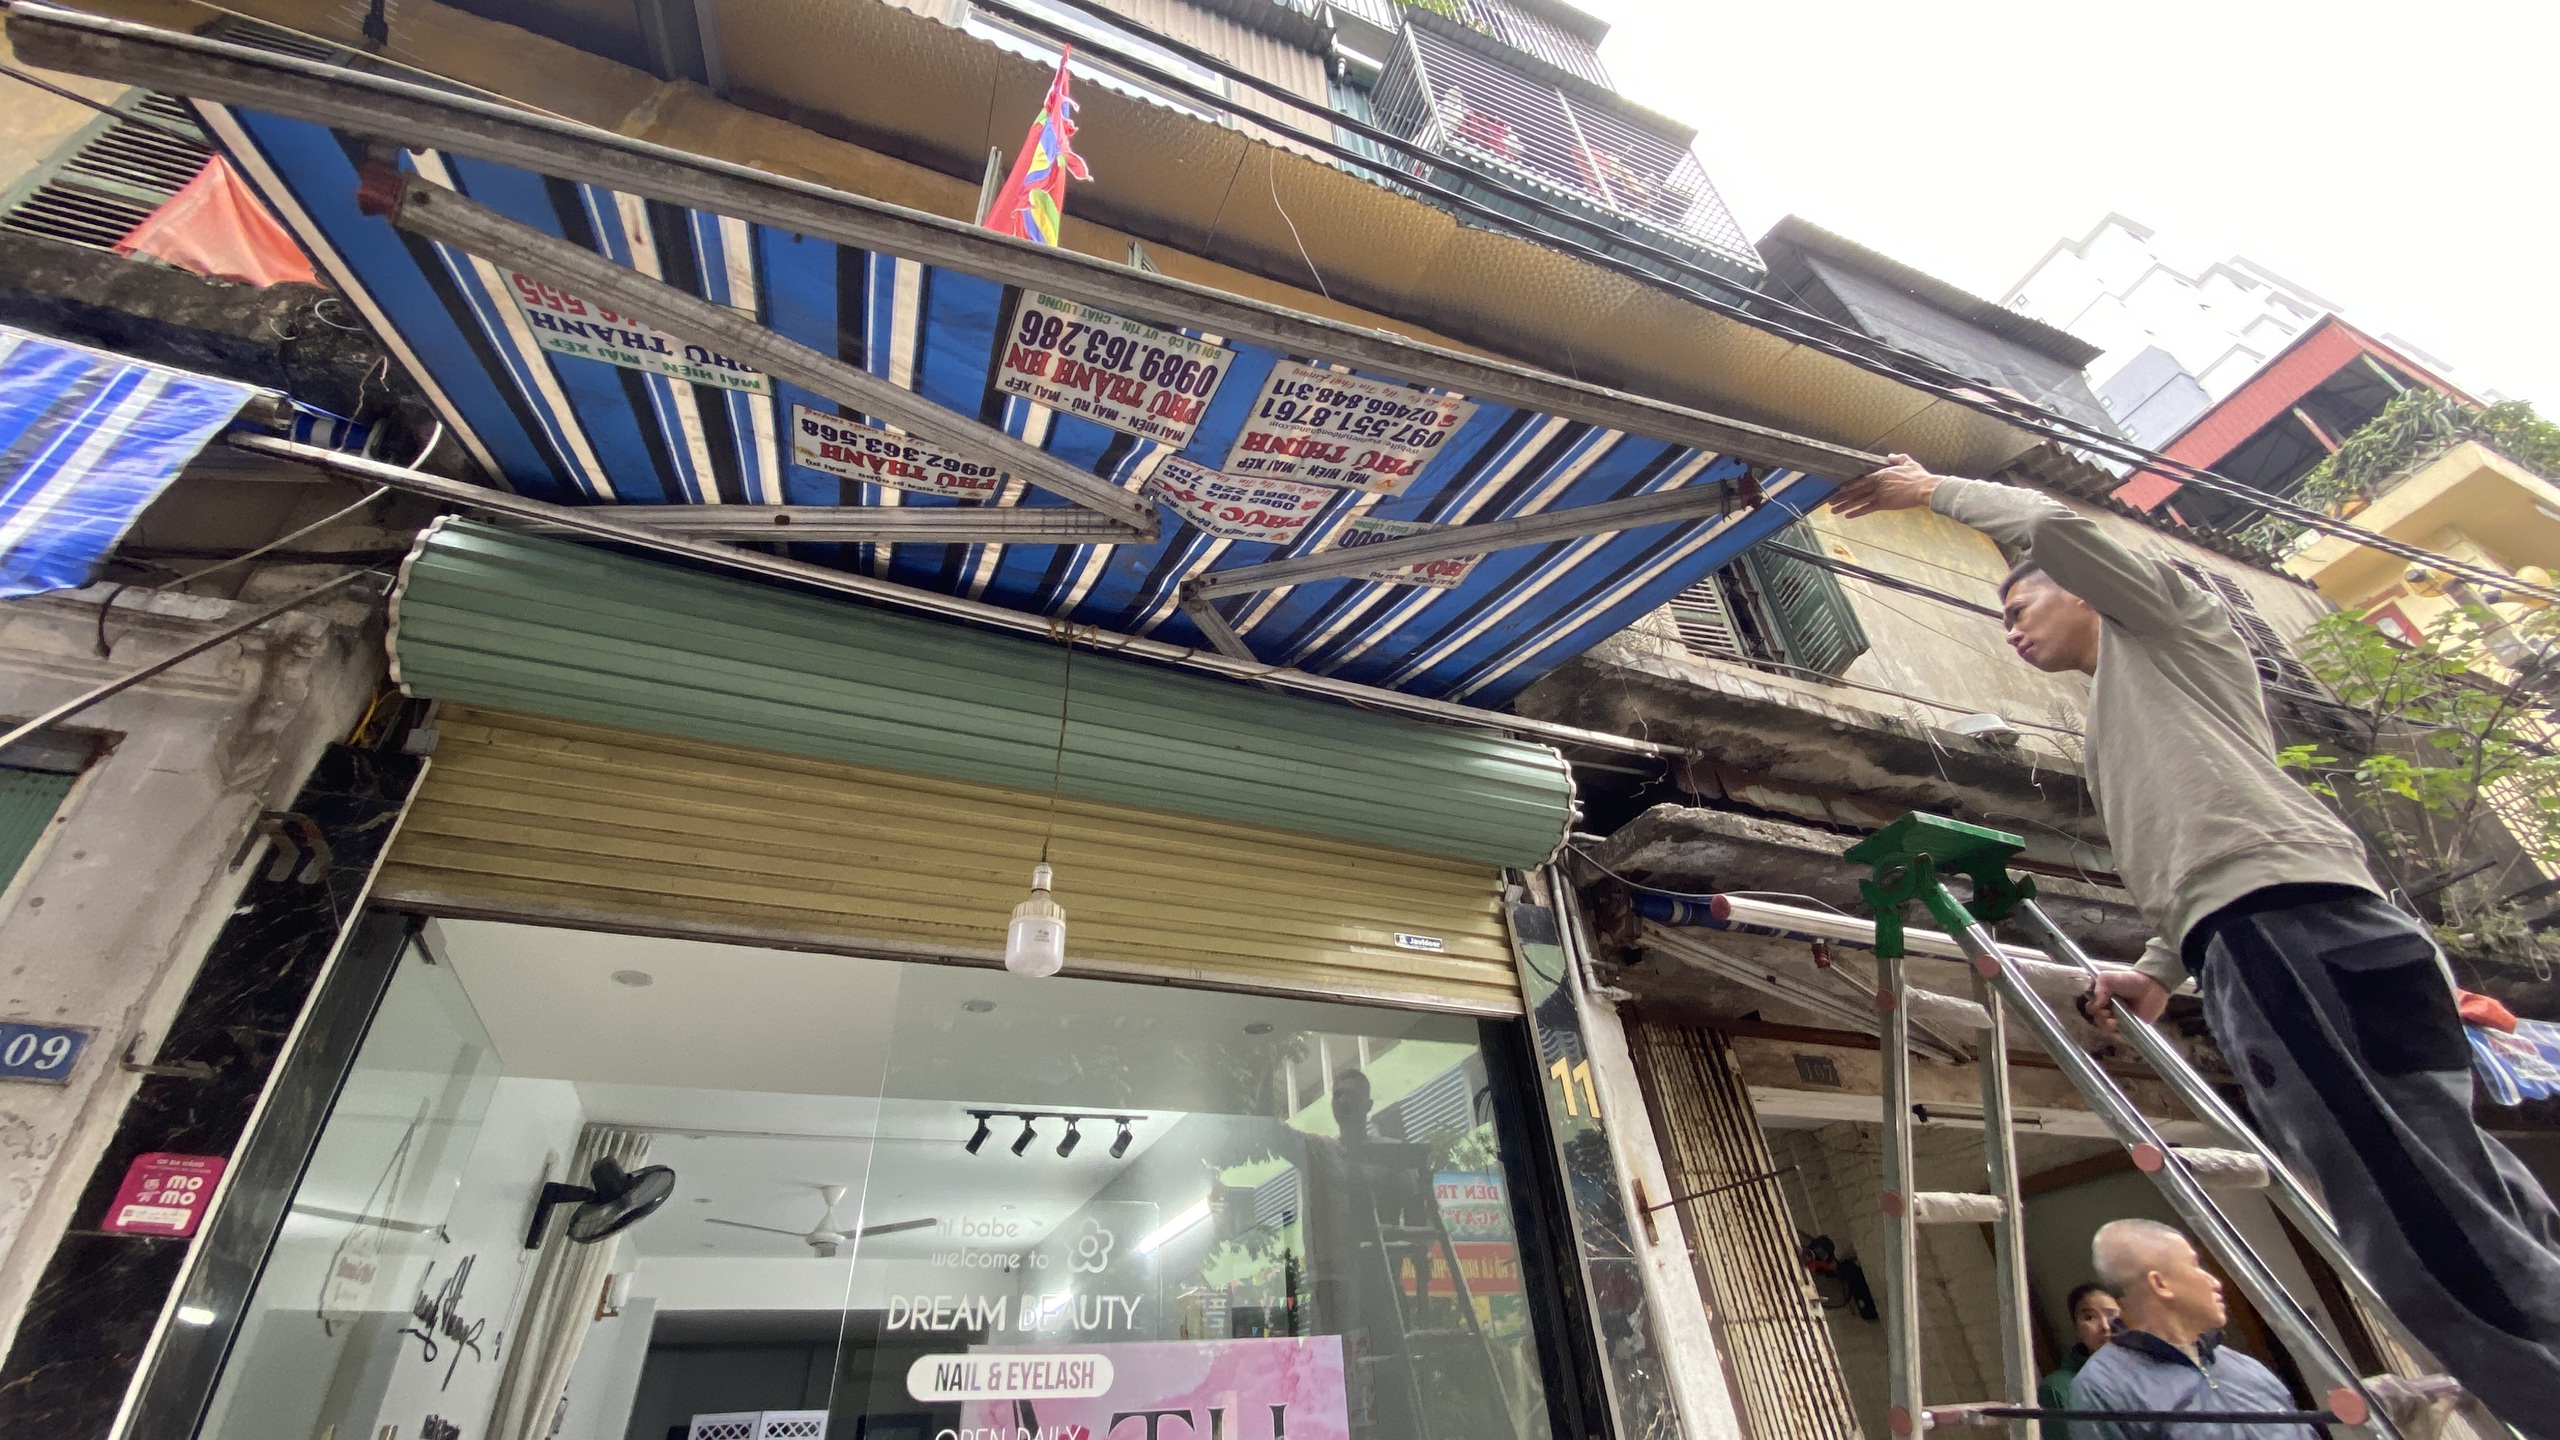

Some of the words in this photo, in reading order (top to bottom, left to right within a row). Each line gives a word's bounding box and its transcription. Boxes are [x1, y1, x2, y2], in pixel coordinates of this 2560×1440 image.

[526, 309, 673, 356] THÀNH
[1004, 343, 1052, 377] HN
[1018, 309, 1219, 398] 0989.163.286
[662, 362, 713, 381] HIÊN
[1050, 356, 1147, 408] THÀNH
[1035, 385, 1062, 403] MÁI
[1071, 397, 1091, 413] RỦ
[1146, 390, 1206, 426] PHÚ
[1272, 378, 1439, 427] 02466.848.311
[1093, 403, 1119, 422] MÁI
[1128, 415, 1159, 436] HIÊN
[1258, 397, 1446, 449] 097.551.8761
[801, 418, 997, 477] 0962.363.568
[1162, 425, 1186, 442] MÁI
[1239, 431, 1351, 464] THỊNH
[819, 442, 928, 482] THÀNH
[1305, 464, 1342, 482] HIÊN
[1350, 449, 1425, 477] PHÚ
[935, 472, 998, 491] PHÚ
[1218, 507, 1311, 529] PHÚC
[0, 1029, 72, 1070] 09
[961, 1216, 1019, 1239] babe
[931, 1247, 1021, 1270] welcome
[1028, 1249, 1050, 1270] to
[886, 1294, 1008, 1331] DREAM
[1018, 1292, 1142, 1331] BEAUTY
[934, 1362, 982, 1392] NAIL
[986, 1362, 1001, 1391] &
[1005, 1361, 1096, 1390] EYELASH
